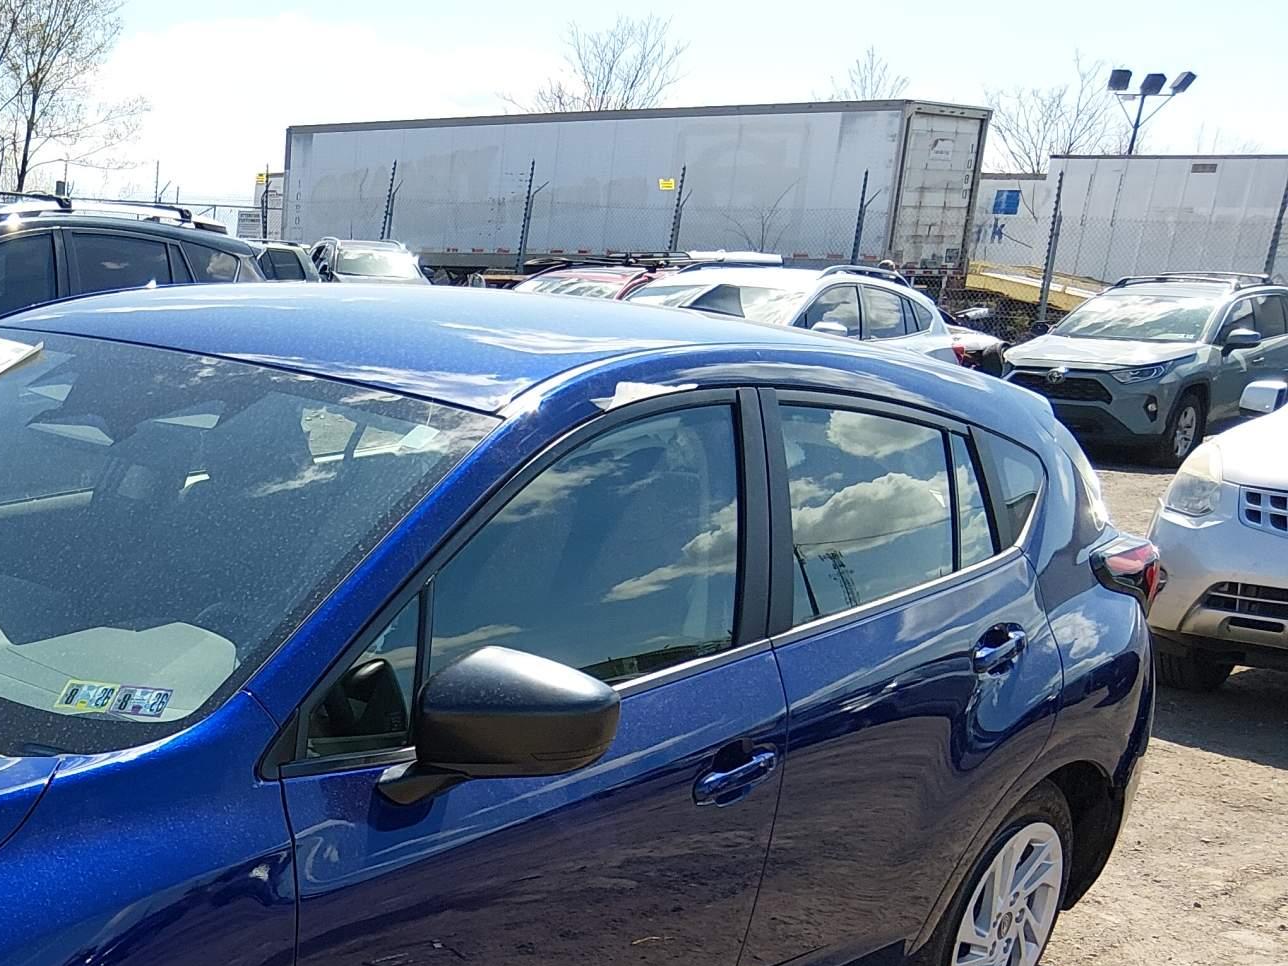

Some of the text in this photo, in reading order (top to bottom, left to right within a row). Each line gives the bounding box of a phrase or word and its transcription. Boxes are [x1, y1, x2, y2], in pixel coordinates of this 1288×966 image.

[64, 688, 79, 705] 8
[118, 692, 169, 712] 8 26
